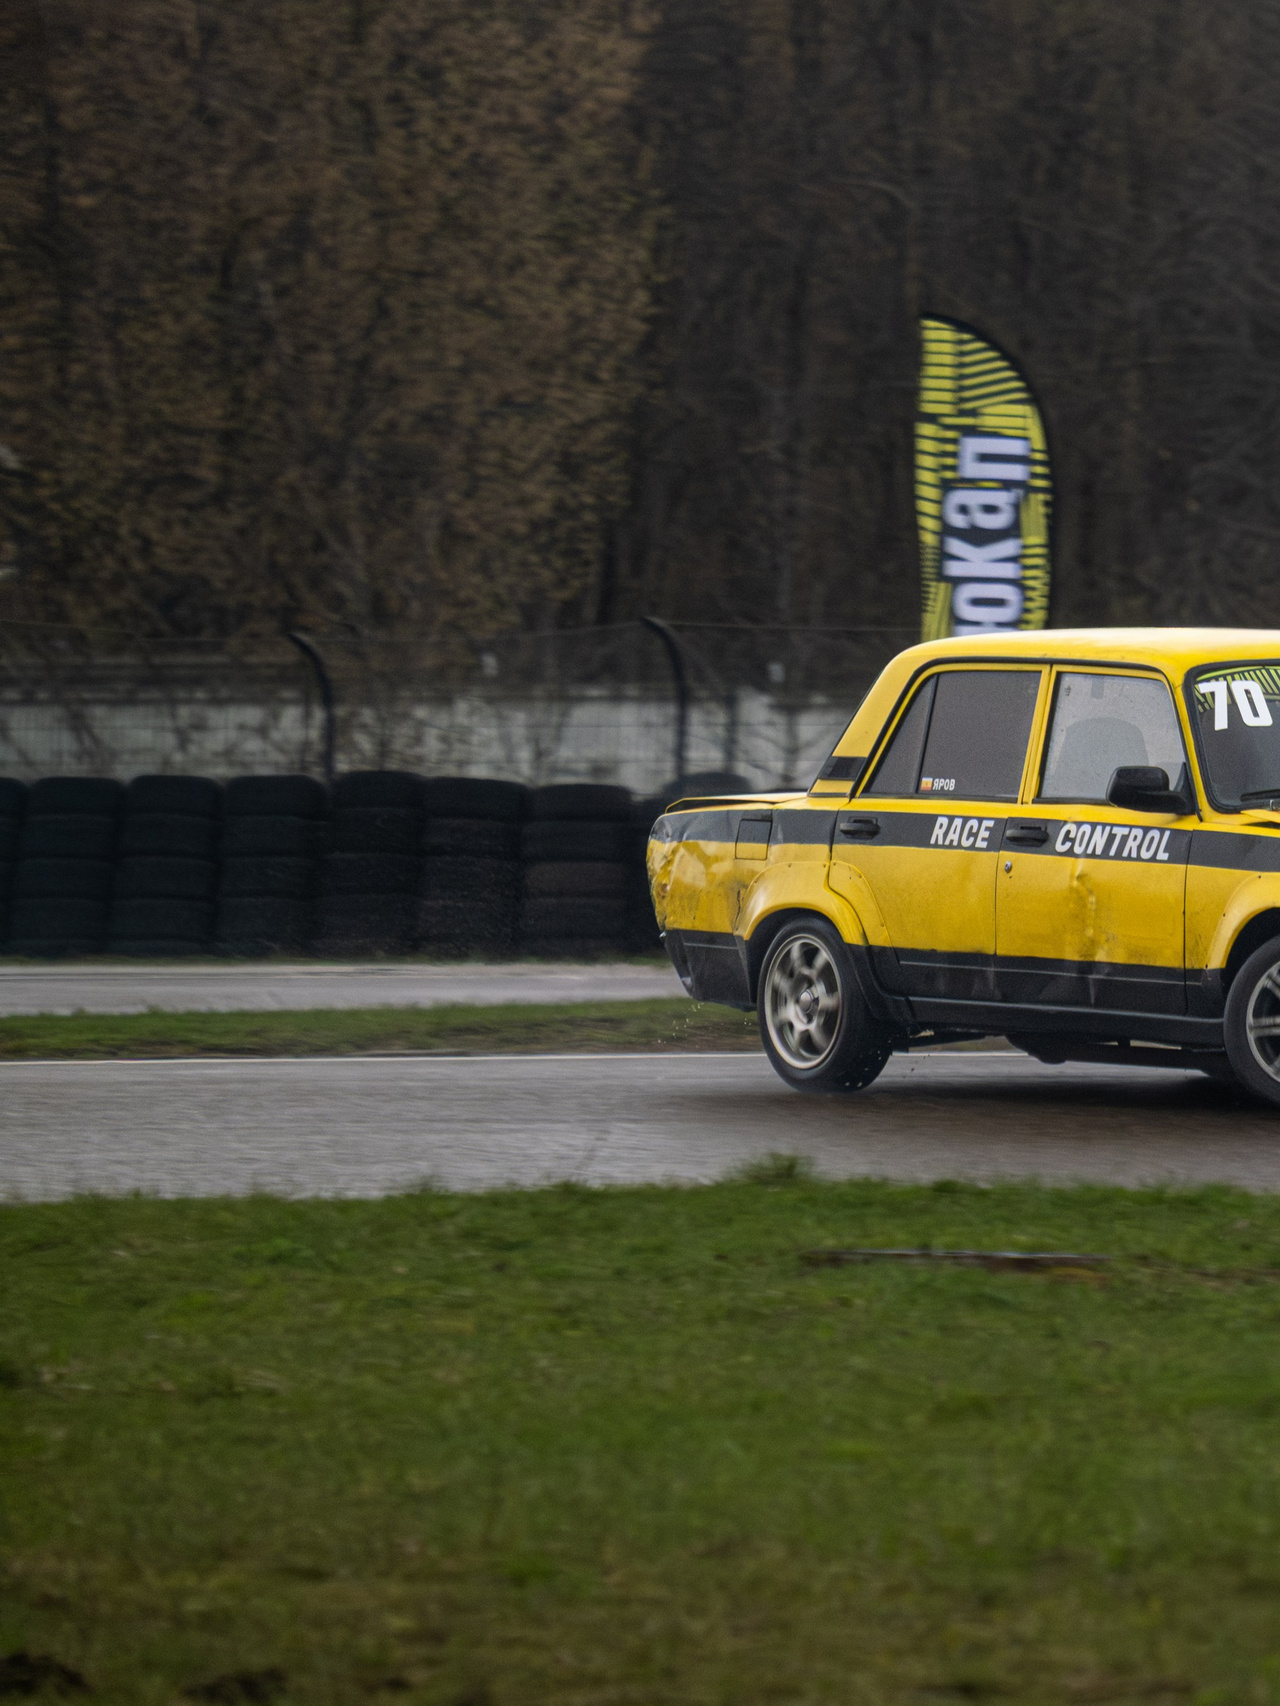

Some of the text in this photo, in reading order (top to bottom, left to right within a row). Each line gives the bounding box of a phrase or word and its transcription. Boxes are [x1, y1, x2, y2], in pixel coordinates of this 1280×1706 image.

[1199, 680, 1273, 731] 70
[932, 778, 956, 791] ЯРОВ
[930, 816, 1170, 861] RACE CONTROL
